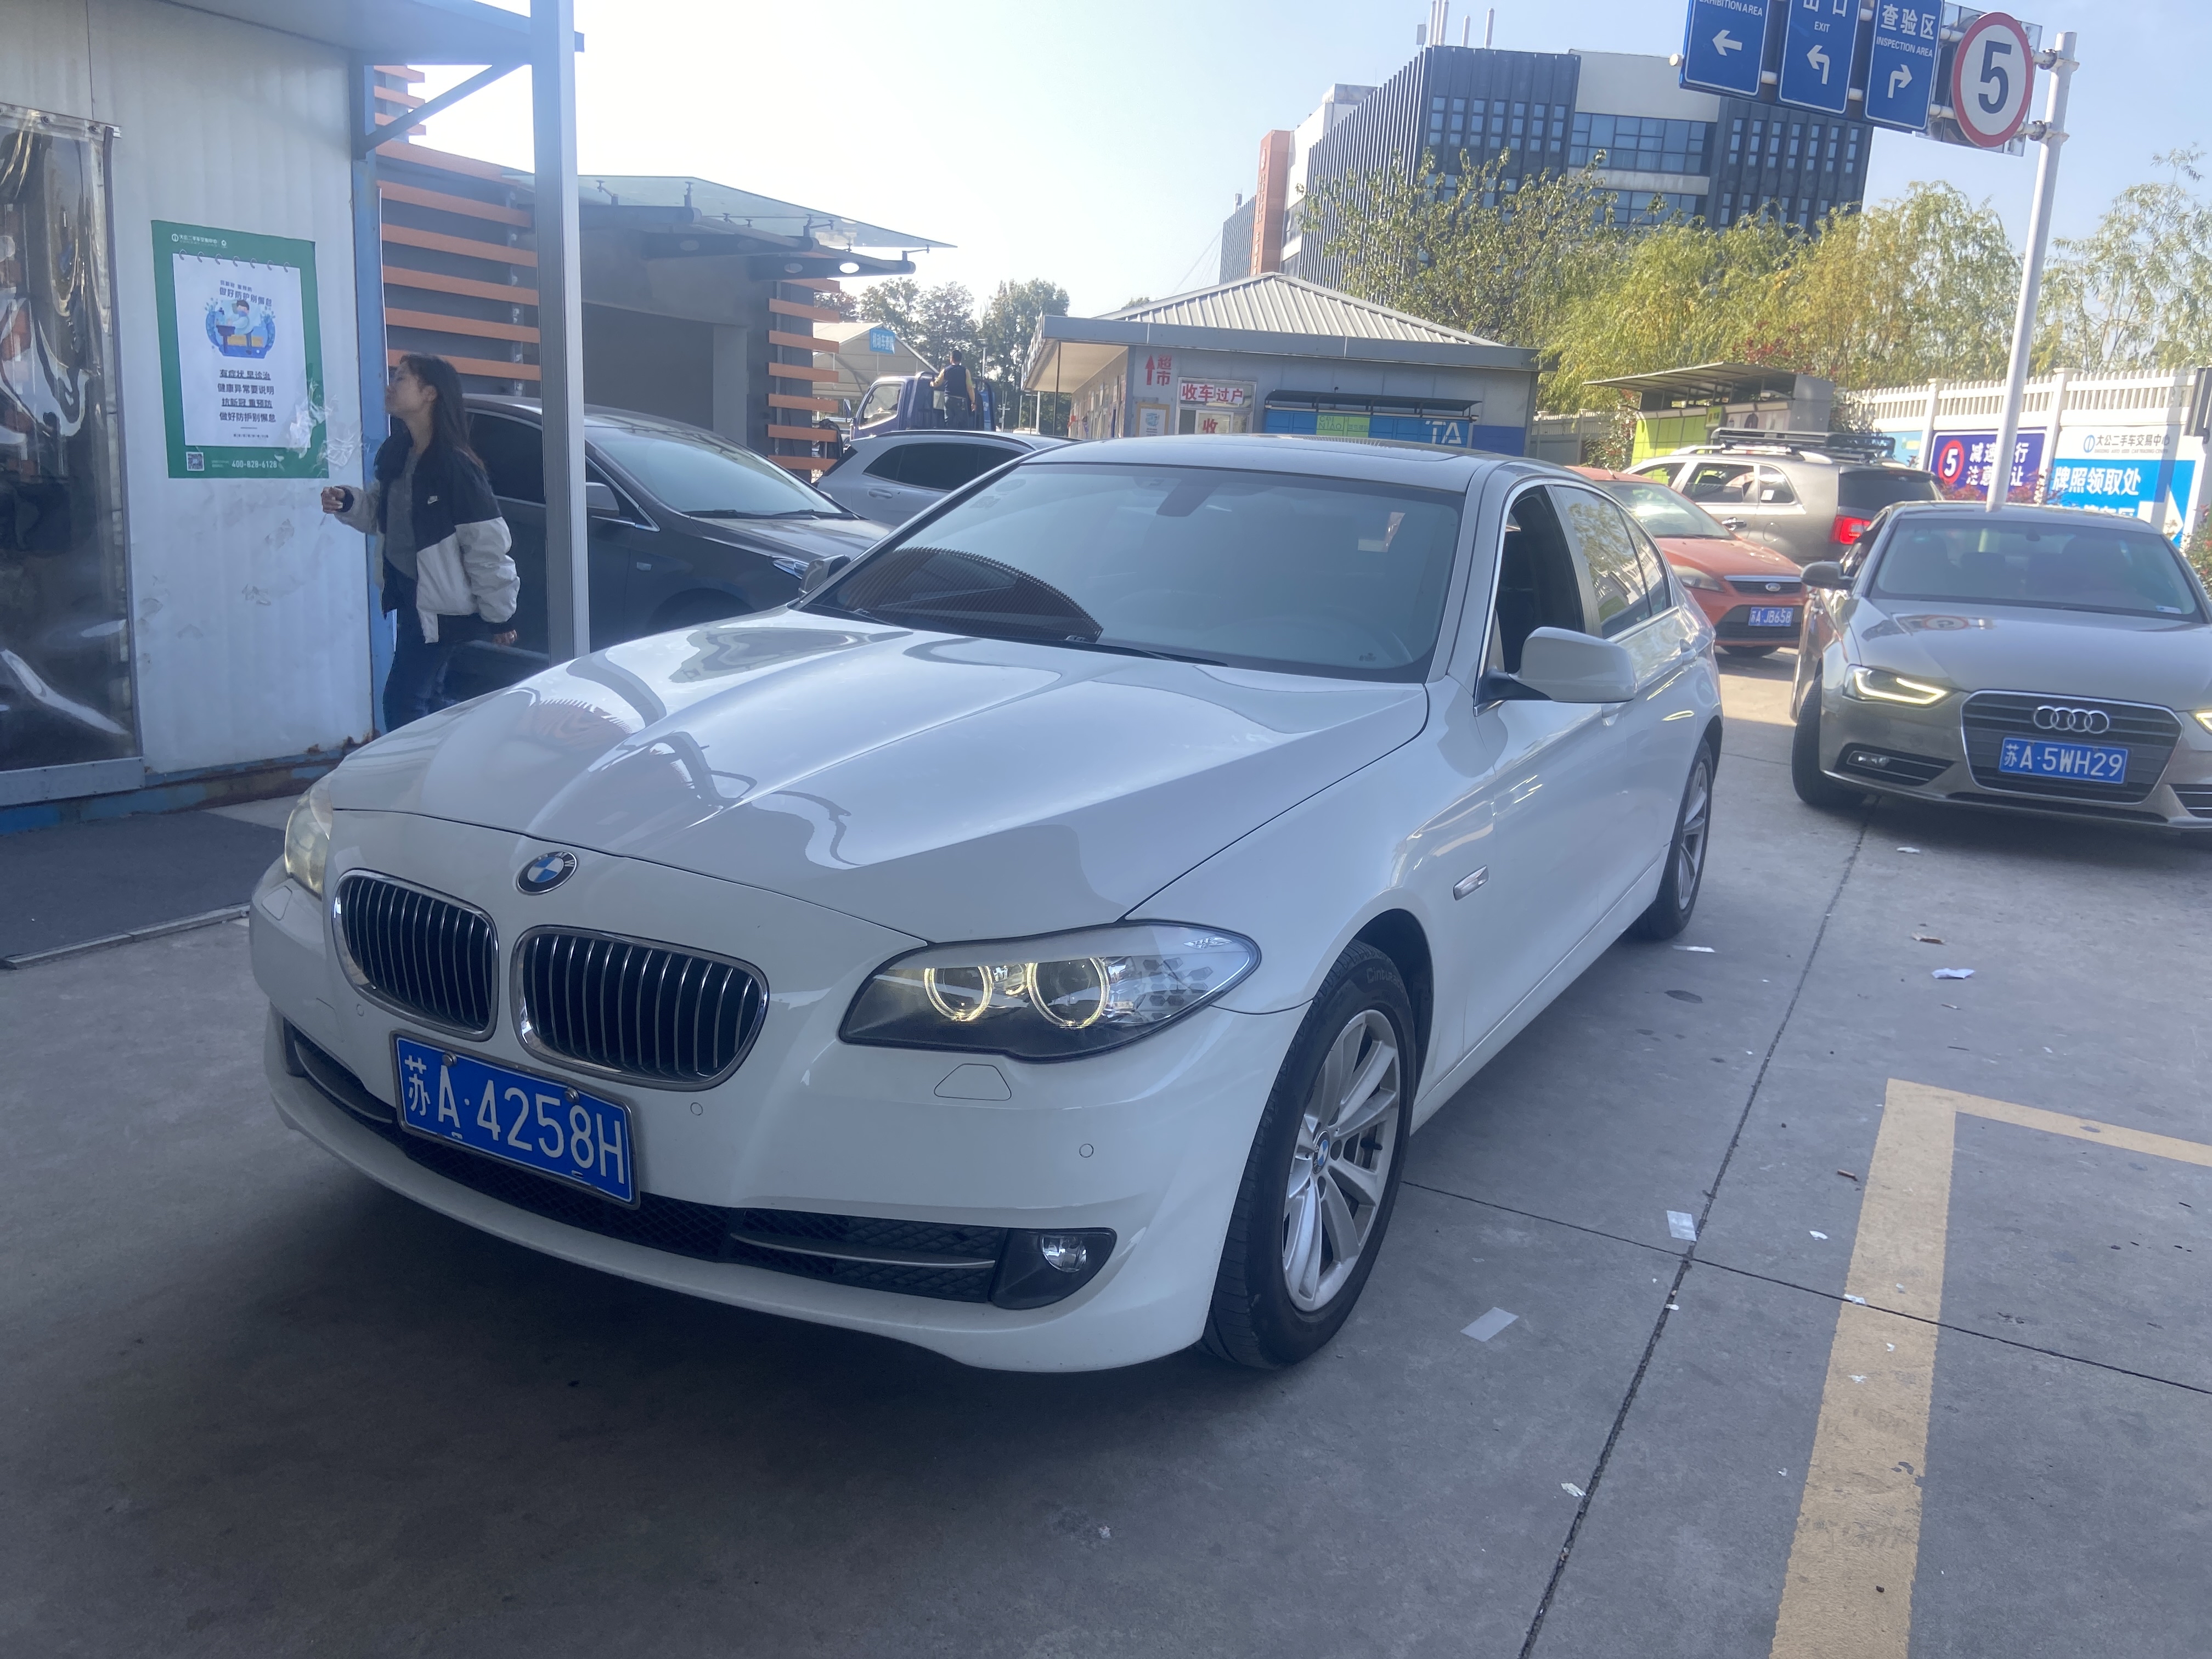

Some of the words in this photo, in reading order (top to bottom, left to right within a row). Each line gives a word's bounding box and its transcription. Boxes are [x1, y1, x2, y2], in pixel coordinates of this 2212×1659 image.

[1700, 0, 1742, 11] HIBITION
[1742, 4, 1762, 16] AREA
[1814, 21, 1830, 33] EXIT
[1881, 4, 1936, 40] 查验区
[1876, 36, 1916, 53] INSPECTION
[1916, 46, 1933, 58] AREA
[1978, 41, 2012, 114] 5
[1156, 354, 1173, 386] 超市
[1182, 383, 1243, 403] 收车过户
[1202, 418, 1218, 433] 收
[2096, 434, 2170, 447] 大公二手车交易中心
[1944, 448, 1959, 477] 5
[1970, 442, 2029, 463] 减速行
[1966, 465, 2024, 487] 注意让
[2052, 466, 2141, 496] 牌照领取处
[2004, 743, 2123, 777] 苏A·5WH29
[404, 1055, 625, 1185] 苏A·4258H
